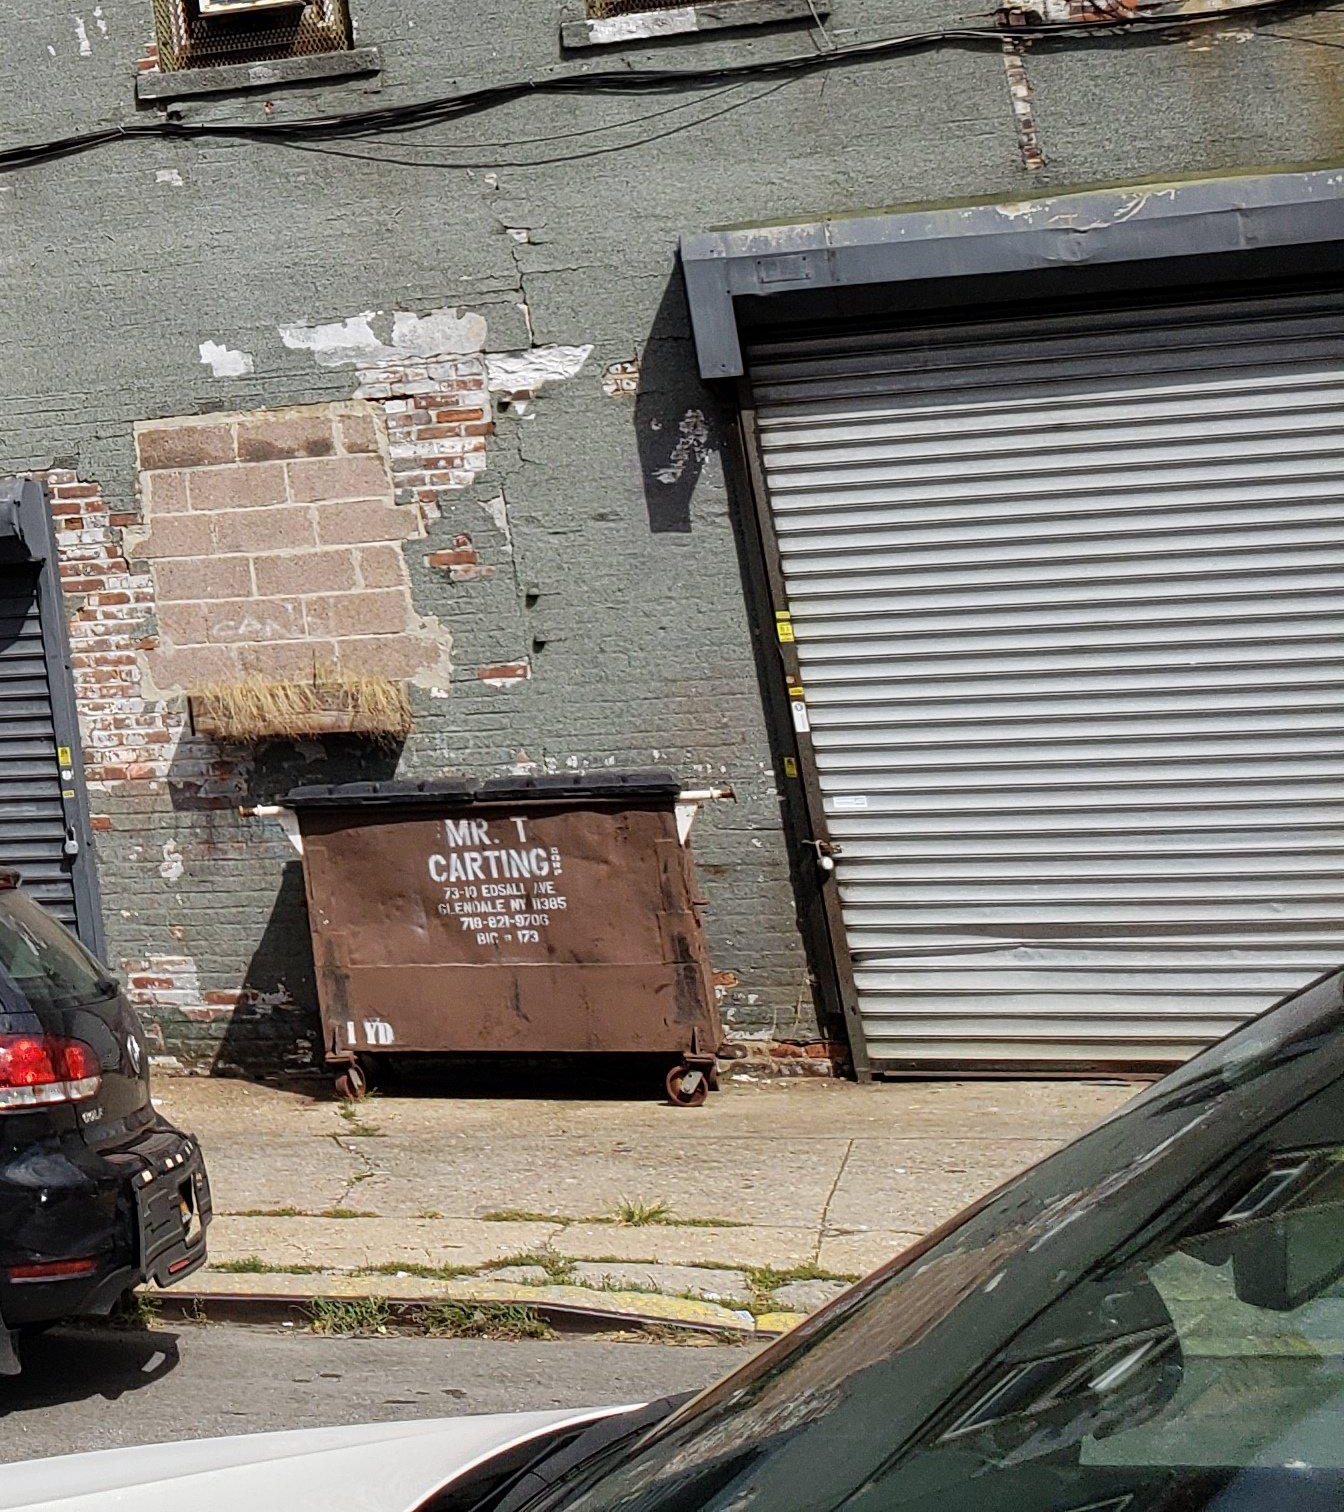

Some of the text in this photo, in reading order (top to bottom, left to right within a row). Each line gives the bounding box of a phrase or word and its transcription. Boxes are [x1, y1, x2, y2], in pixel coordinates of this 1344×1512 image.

[444, 815, 528, 848] MR. T
[428, 847, 550, 883] CARTING
[443, 885, 478, 899] 73-10
[437, 898, 506, 915] GLENDALE
[509, 898, 527, 912] NY
